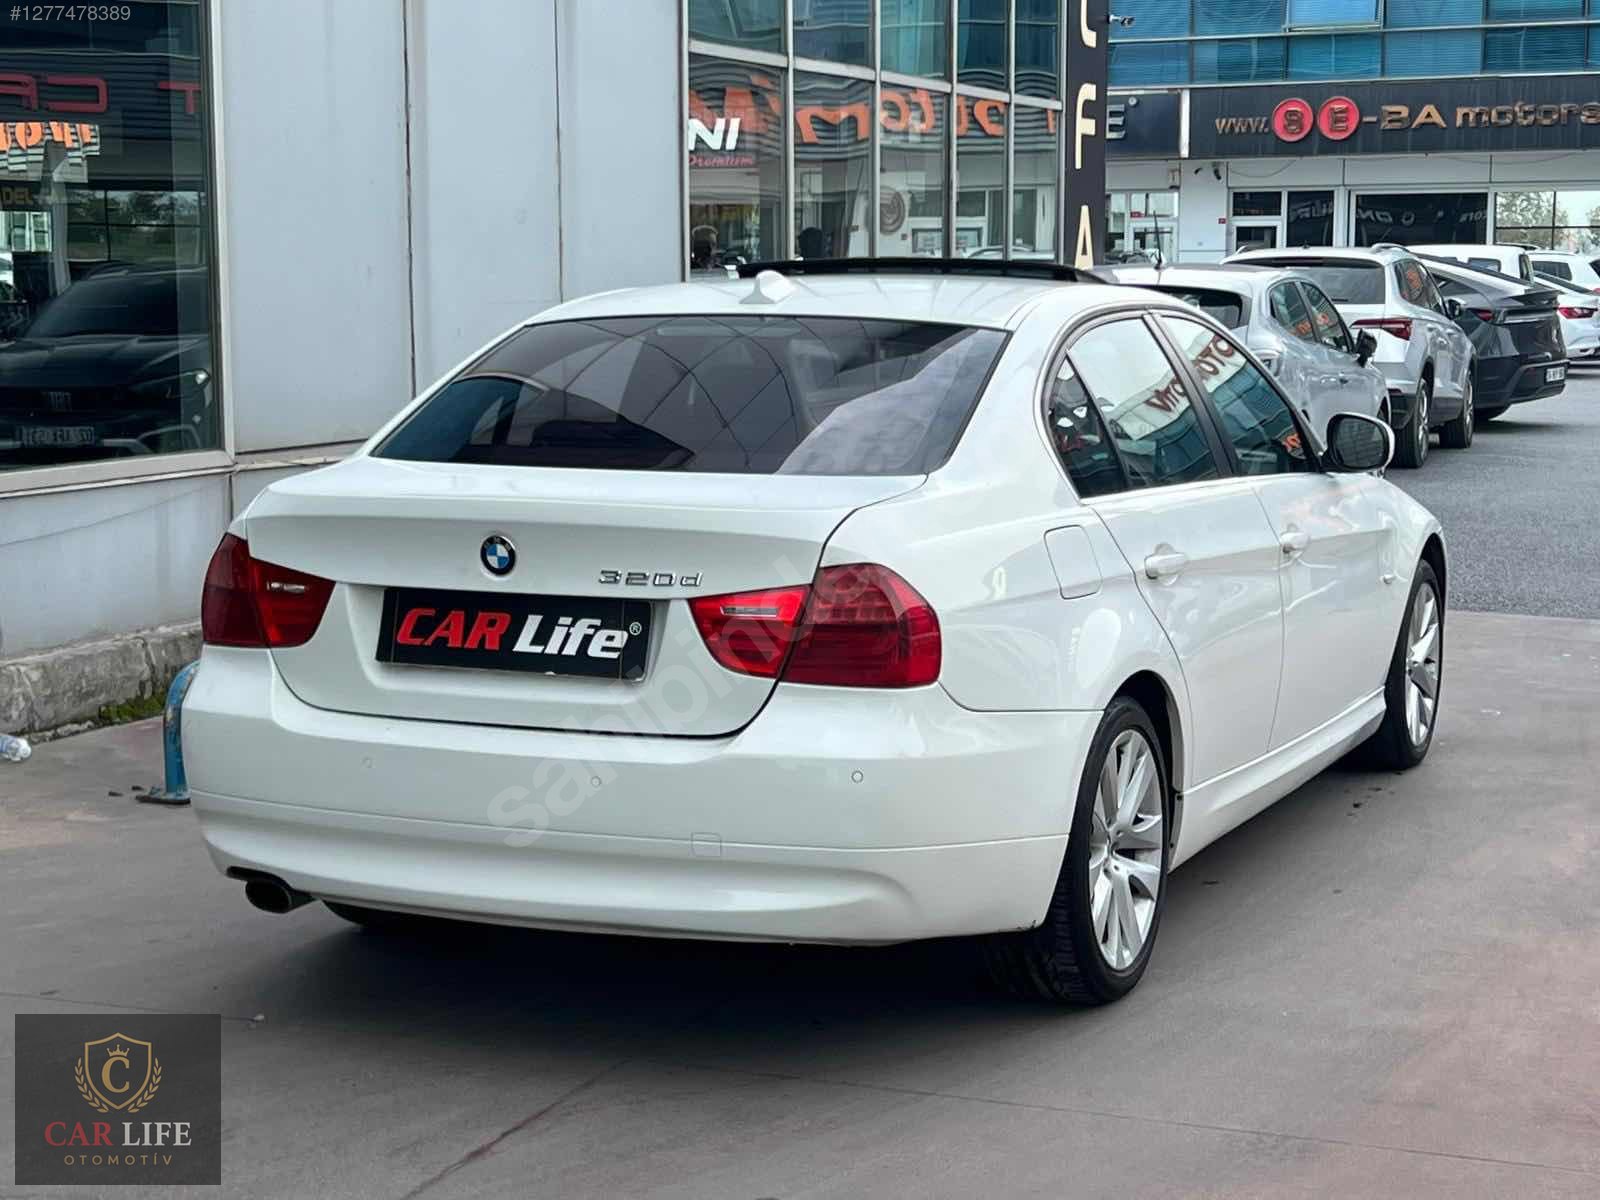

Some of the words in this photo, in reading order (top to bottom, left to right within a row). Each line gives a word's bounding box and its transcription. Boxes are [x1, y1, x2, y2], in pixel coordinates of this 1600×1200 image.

[1455, 101, 1600, 128] motors
[598, 569, 704, 587] 320d
[397, 607, 512, 650] CAR
